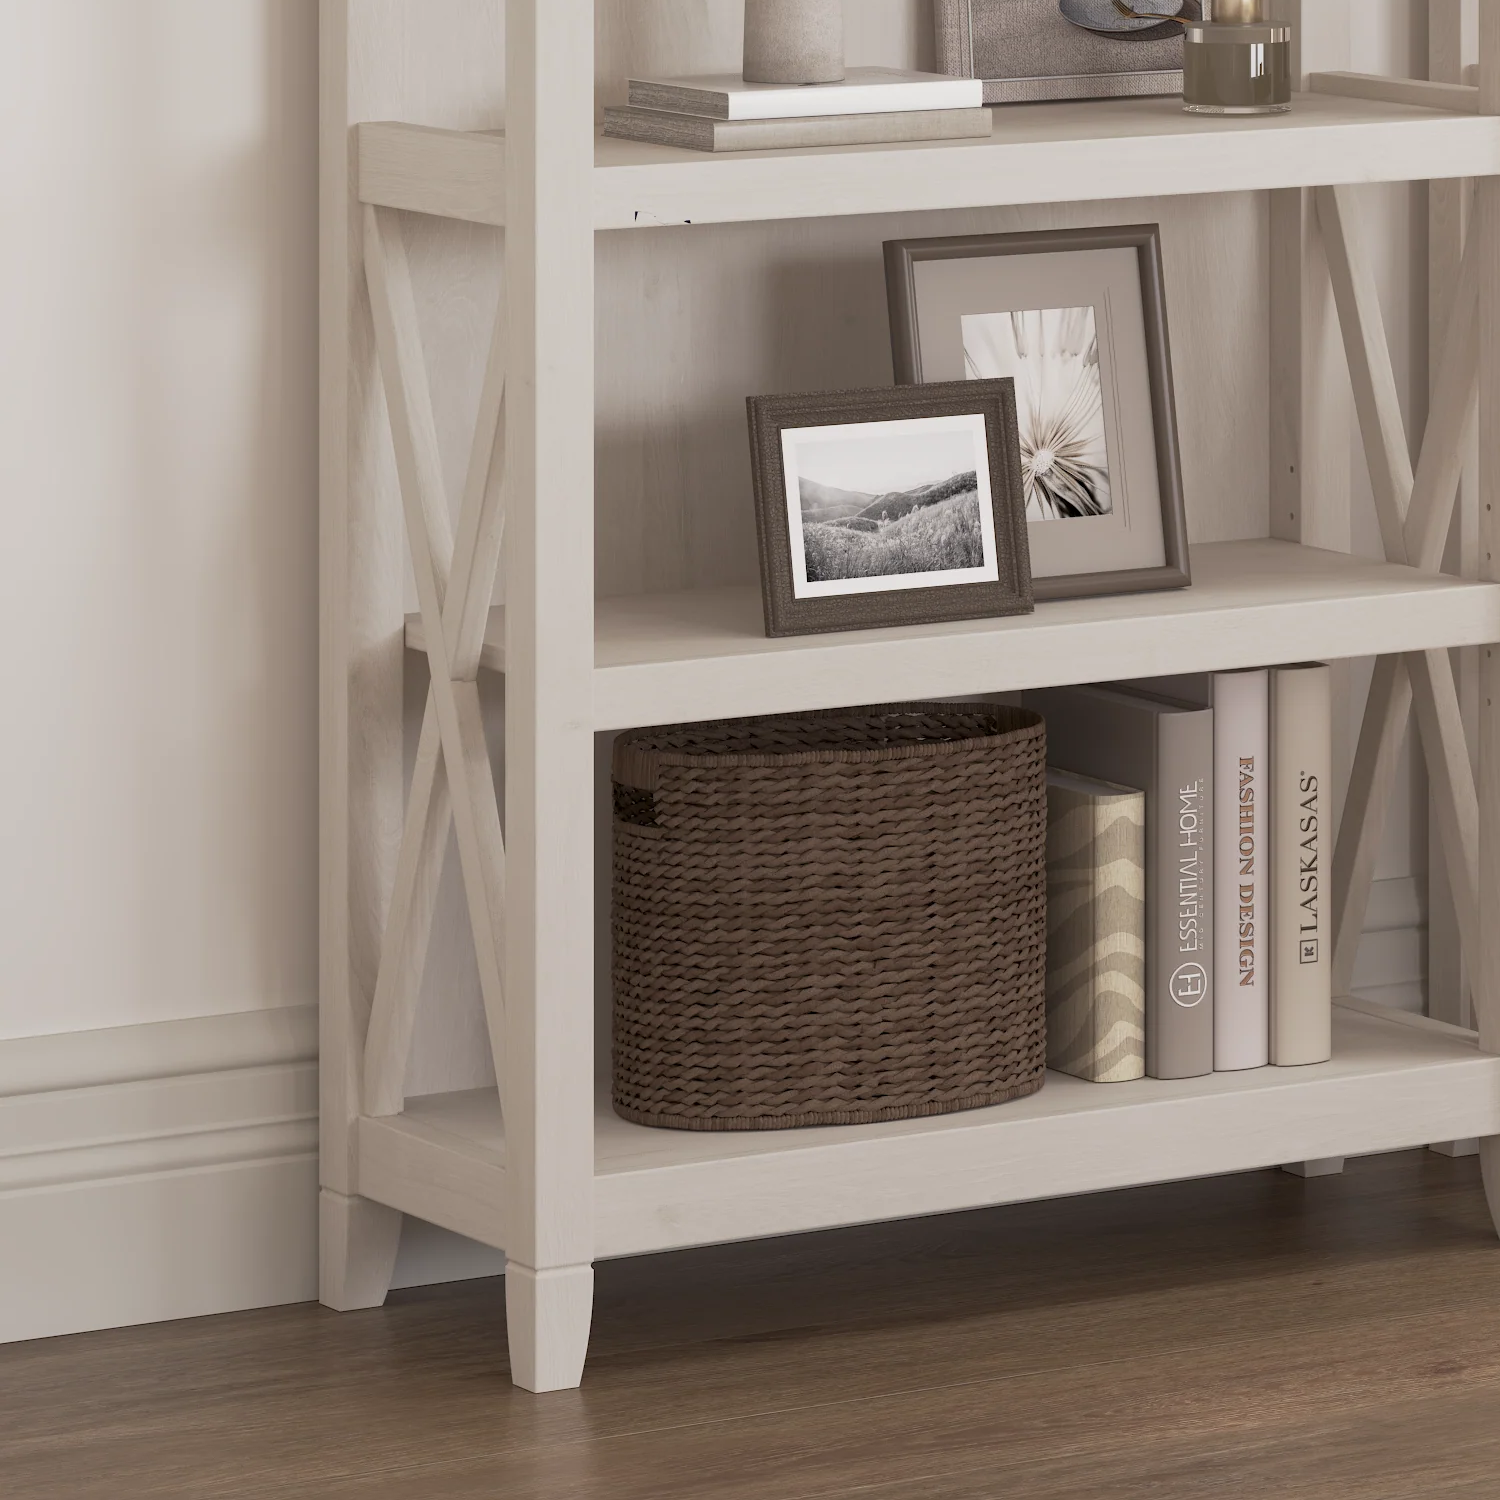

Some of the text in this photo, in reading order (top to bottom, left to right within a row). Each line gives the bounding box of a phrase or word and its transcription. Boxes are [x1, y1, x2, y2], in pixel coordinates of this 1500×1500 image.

[1179, 780, 1198, 952] ESSENTIAL HOME
[1238, 756, 1255, 987] FASHION DESIGN
